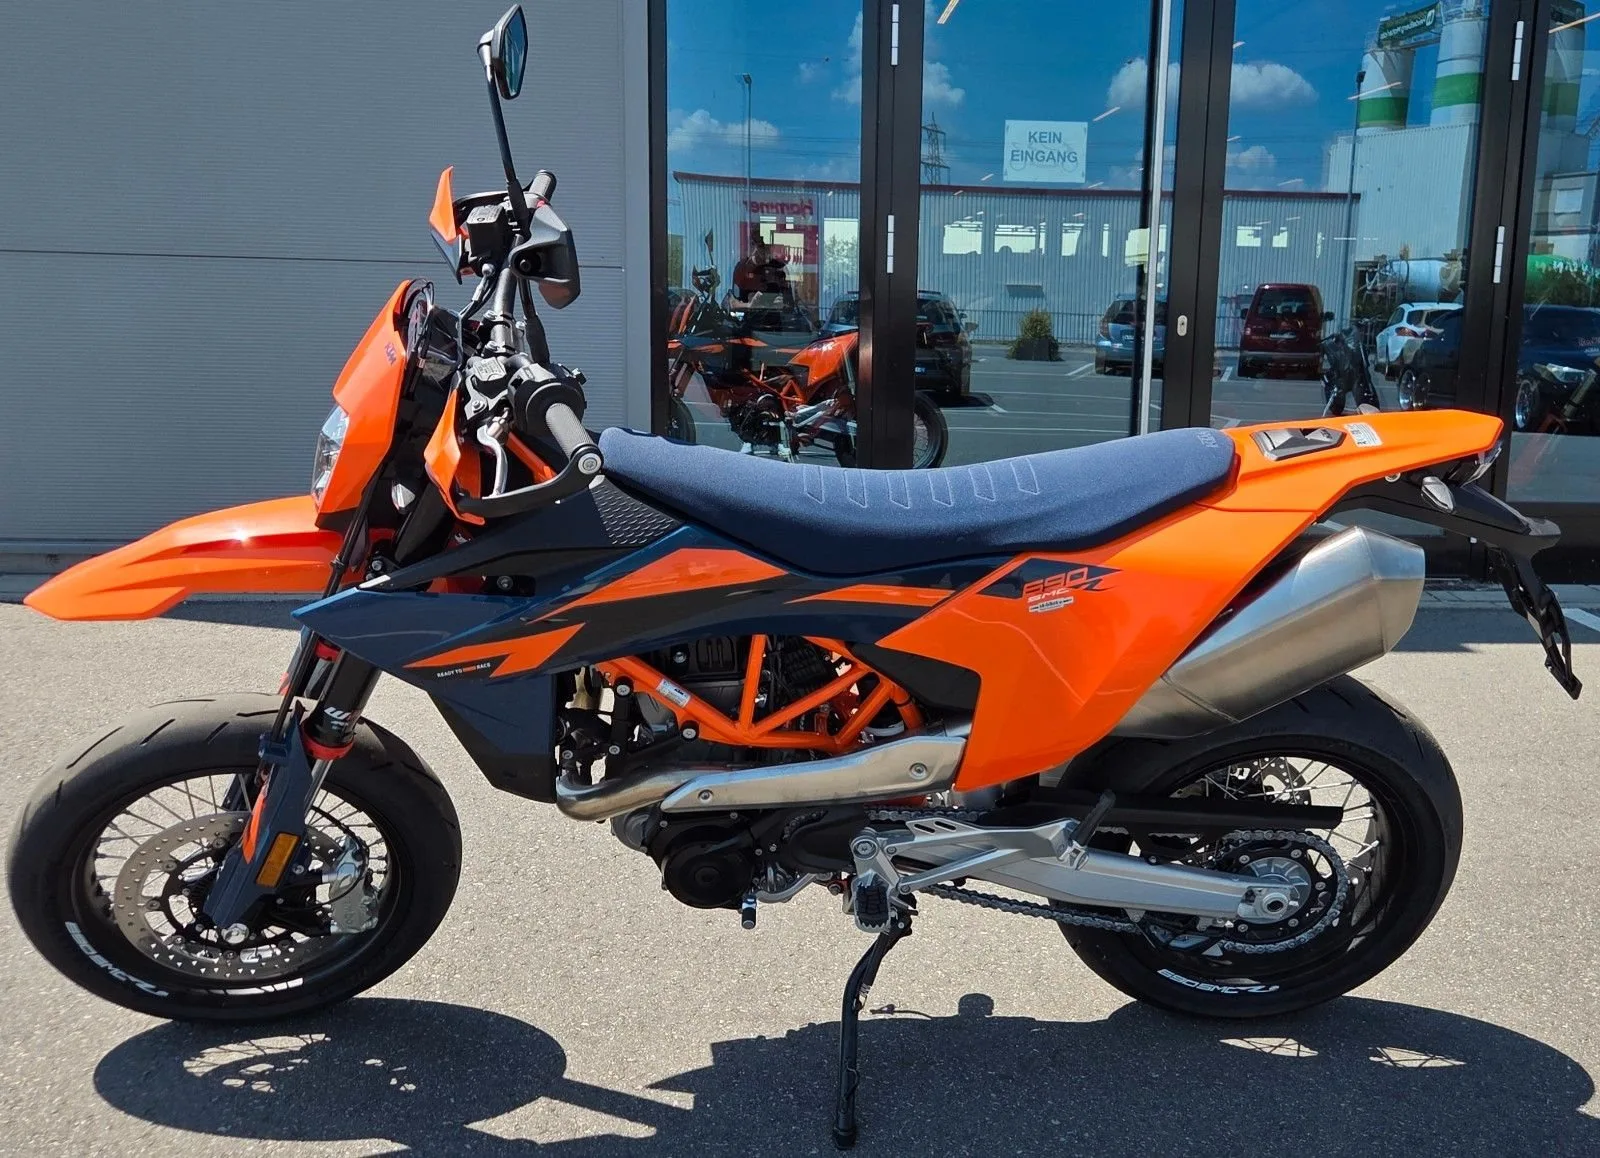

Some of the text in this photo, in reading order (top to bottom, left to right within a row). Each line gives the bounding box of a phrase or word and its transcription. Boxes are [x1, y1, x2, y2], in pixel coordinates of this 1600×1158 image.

[1028, 131, 1062, 144] KEIN
[1010, 150, 1078, 163] EINGANG
[1027, 587, 1070, 602] SMC
